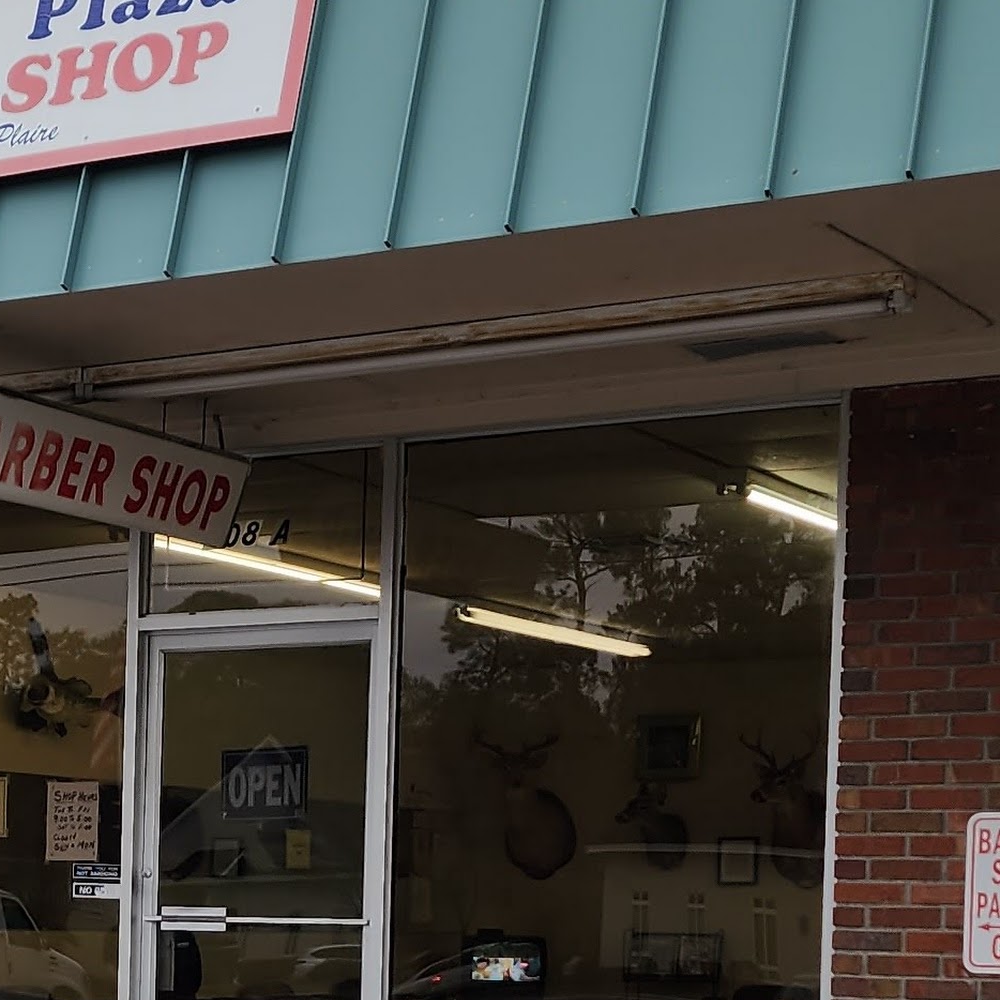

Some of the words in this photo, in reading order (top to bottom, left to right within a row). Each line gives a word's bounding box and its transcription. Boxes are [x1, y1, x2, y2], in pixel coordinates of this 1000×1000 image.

[27, 0, 238, 40] Plaz
[0, 21, 229, 113] SHOP
[123, 455, 230, 531] SHOP
[269, 519, 290, 546] A
[54, 791, 77, 802] SHOP
[228, 763, 302, 808] OPEN
[78, 885, 93, 895] NO
